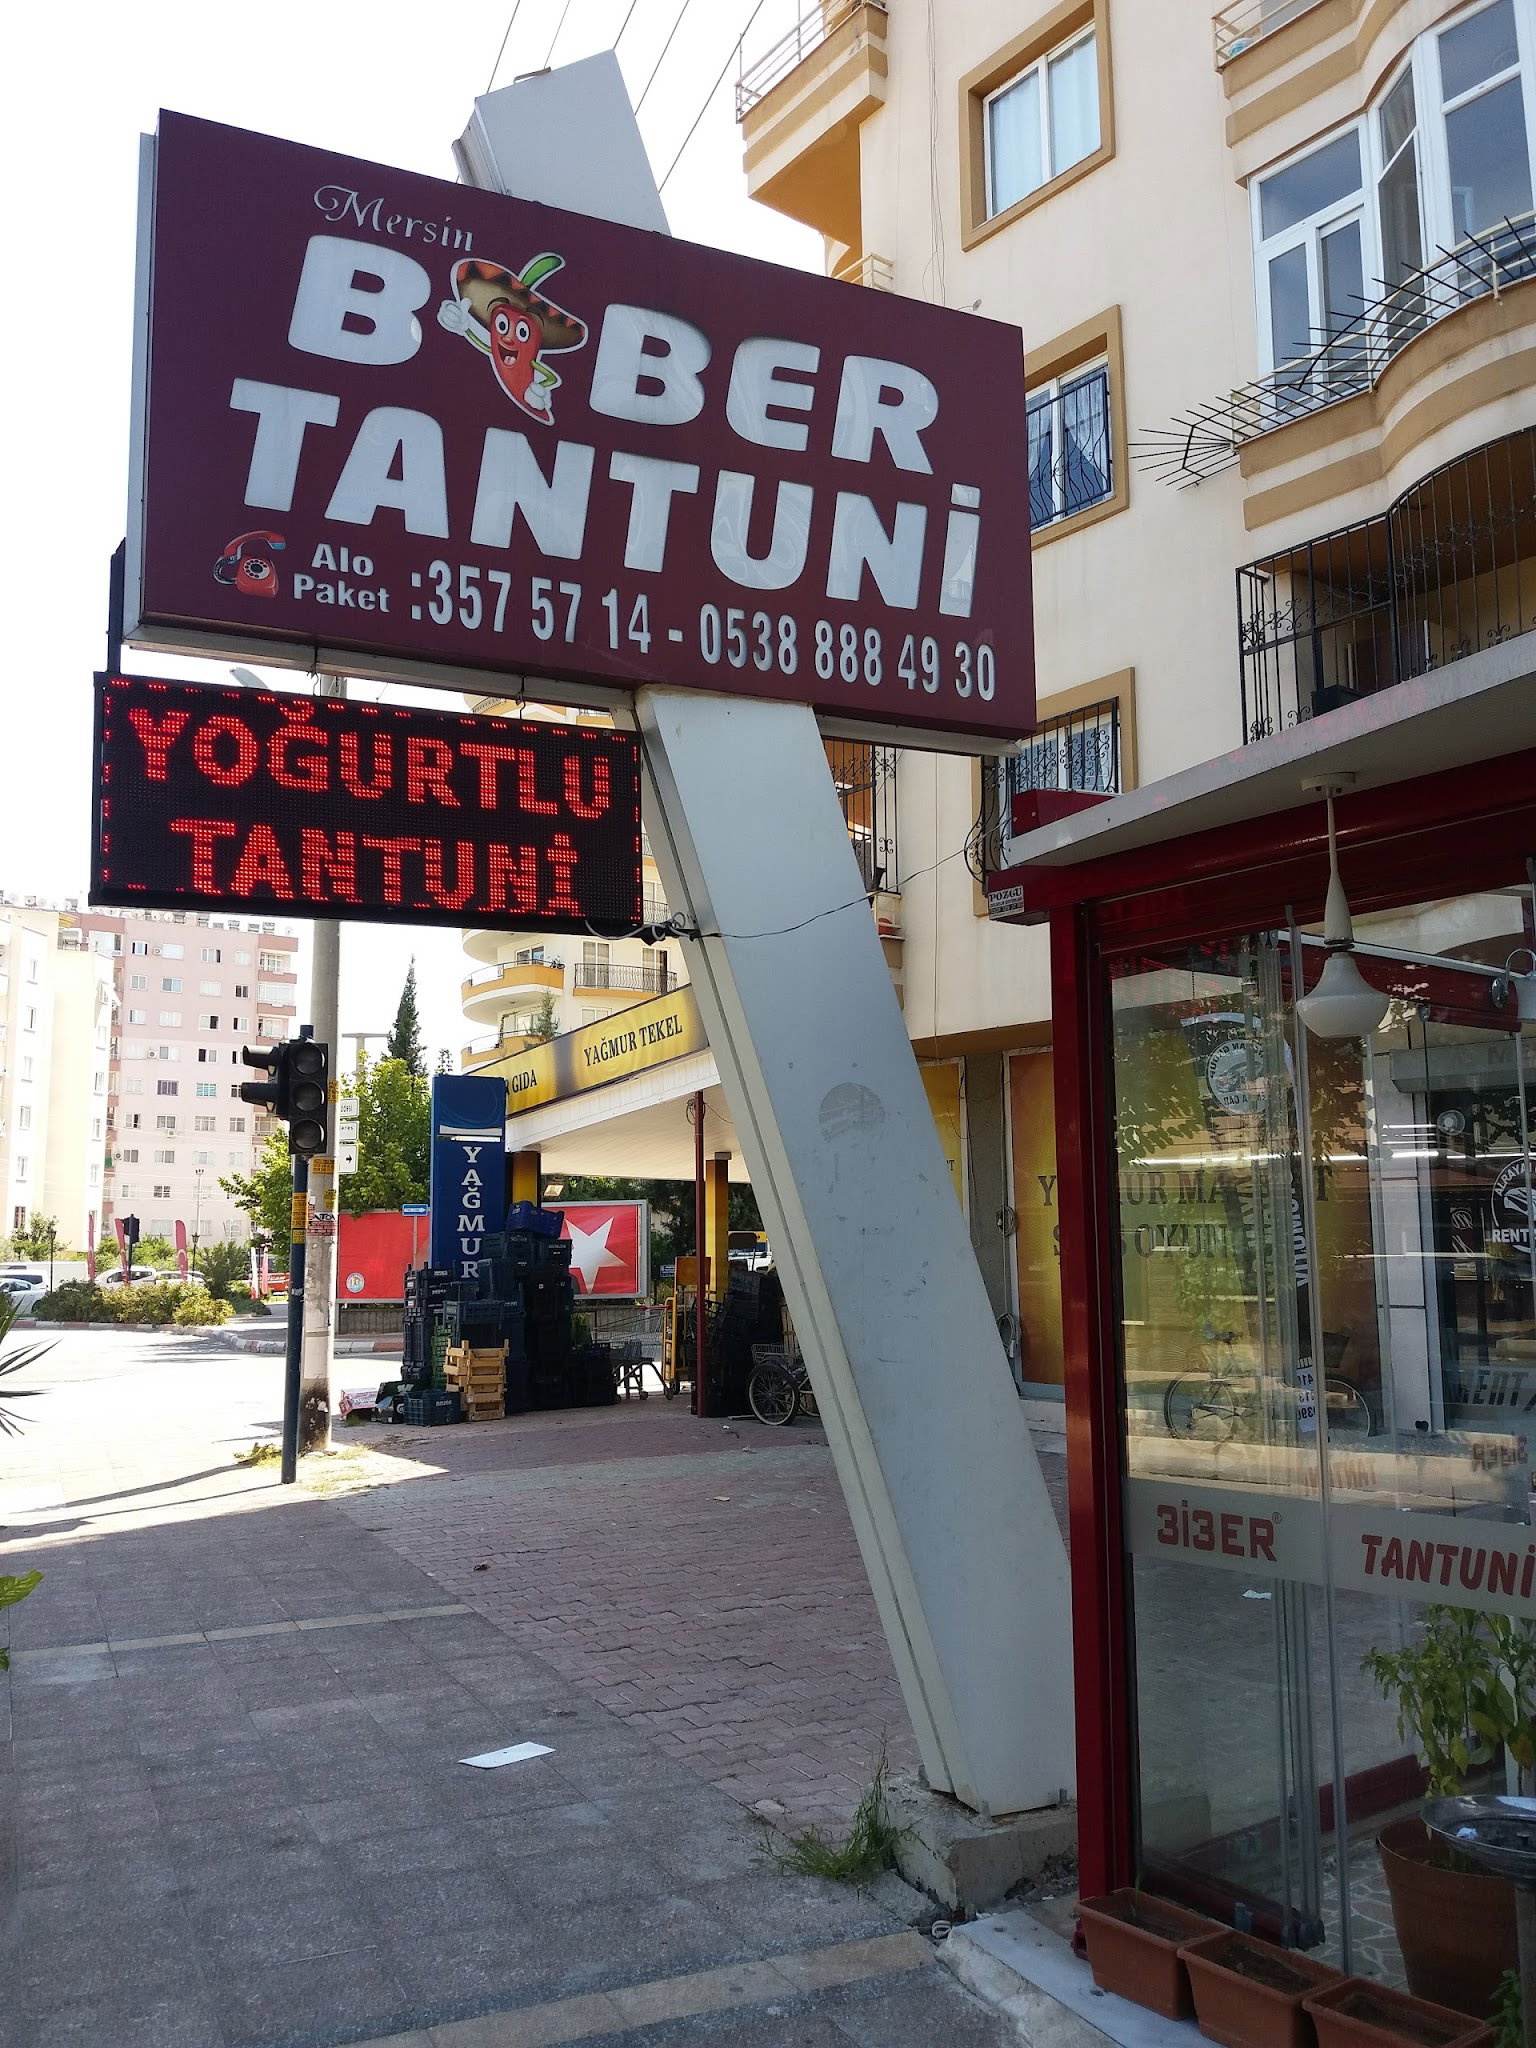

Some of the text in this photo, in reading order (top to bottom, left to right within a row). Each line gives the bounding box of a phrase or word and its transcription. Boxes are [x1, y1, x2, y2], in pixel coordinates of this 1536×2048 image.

[313, 184, 474, 252] Mersin
[311, 543, 374, 578] Alo
[293, 572, 390, 613] Paket
[530, 576, 583, 643] 57
[601, 587, 651, 654] 14
[700, 603, 798, 675] 0538
[814, 619, 883, 687] 888
[898, 634, 940, 695] 49
[955, 641, 996, 702] 30
[128, 700, 611, 819] YOĞURTLU
[583, 1014, 683, 1067] YAĞMUR TEKEL
[511, 1070, 537, 1093] GIDA
[457, 1146, 485, 1279] YAĞMUR
[1492, 1228, 1528, 1243] RENT
